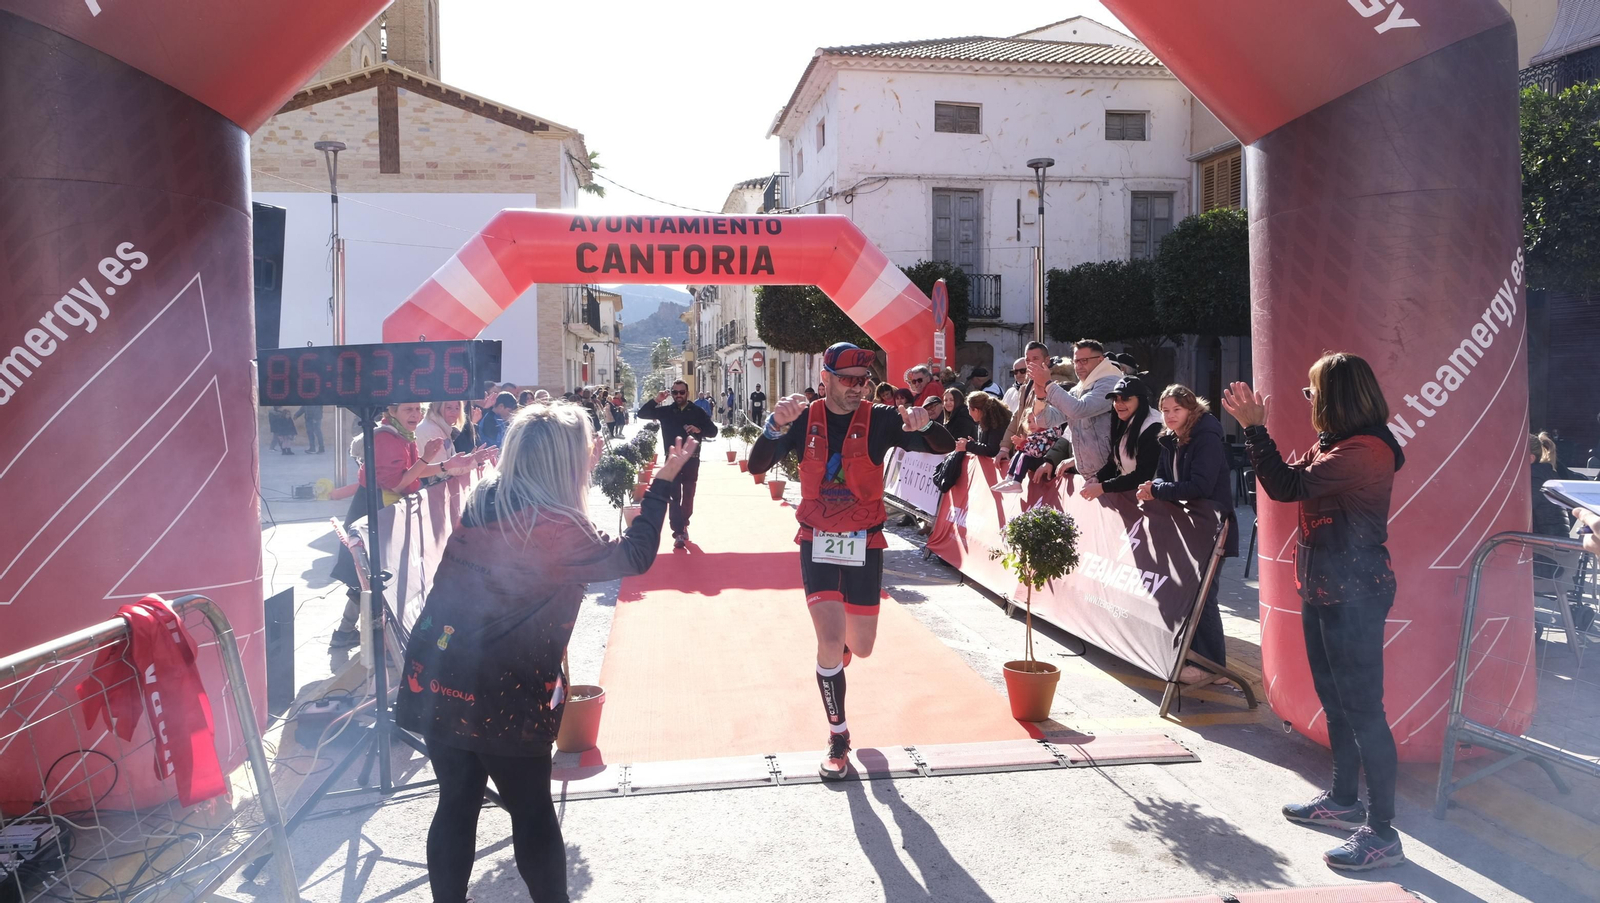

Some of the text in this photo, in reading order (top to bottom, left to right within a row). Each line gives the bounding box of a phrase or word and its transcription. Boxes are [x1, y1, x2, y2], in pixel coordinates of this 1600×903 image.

[569, 215, 782, 235] AYUNTAMIENTO
[576, 242, 775, 275] CANTORIA
[825, 538, 854, 555] 211
[1077, 551, 1169, 600] TEAMERGY
[440, 685, 475, 702] VEOLIA
